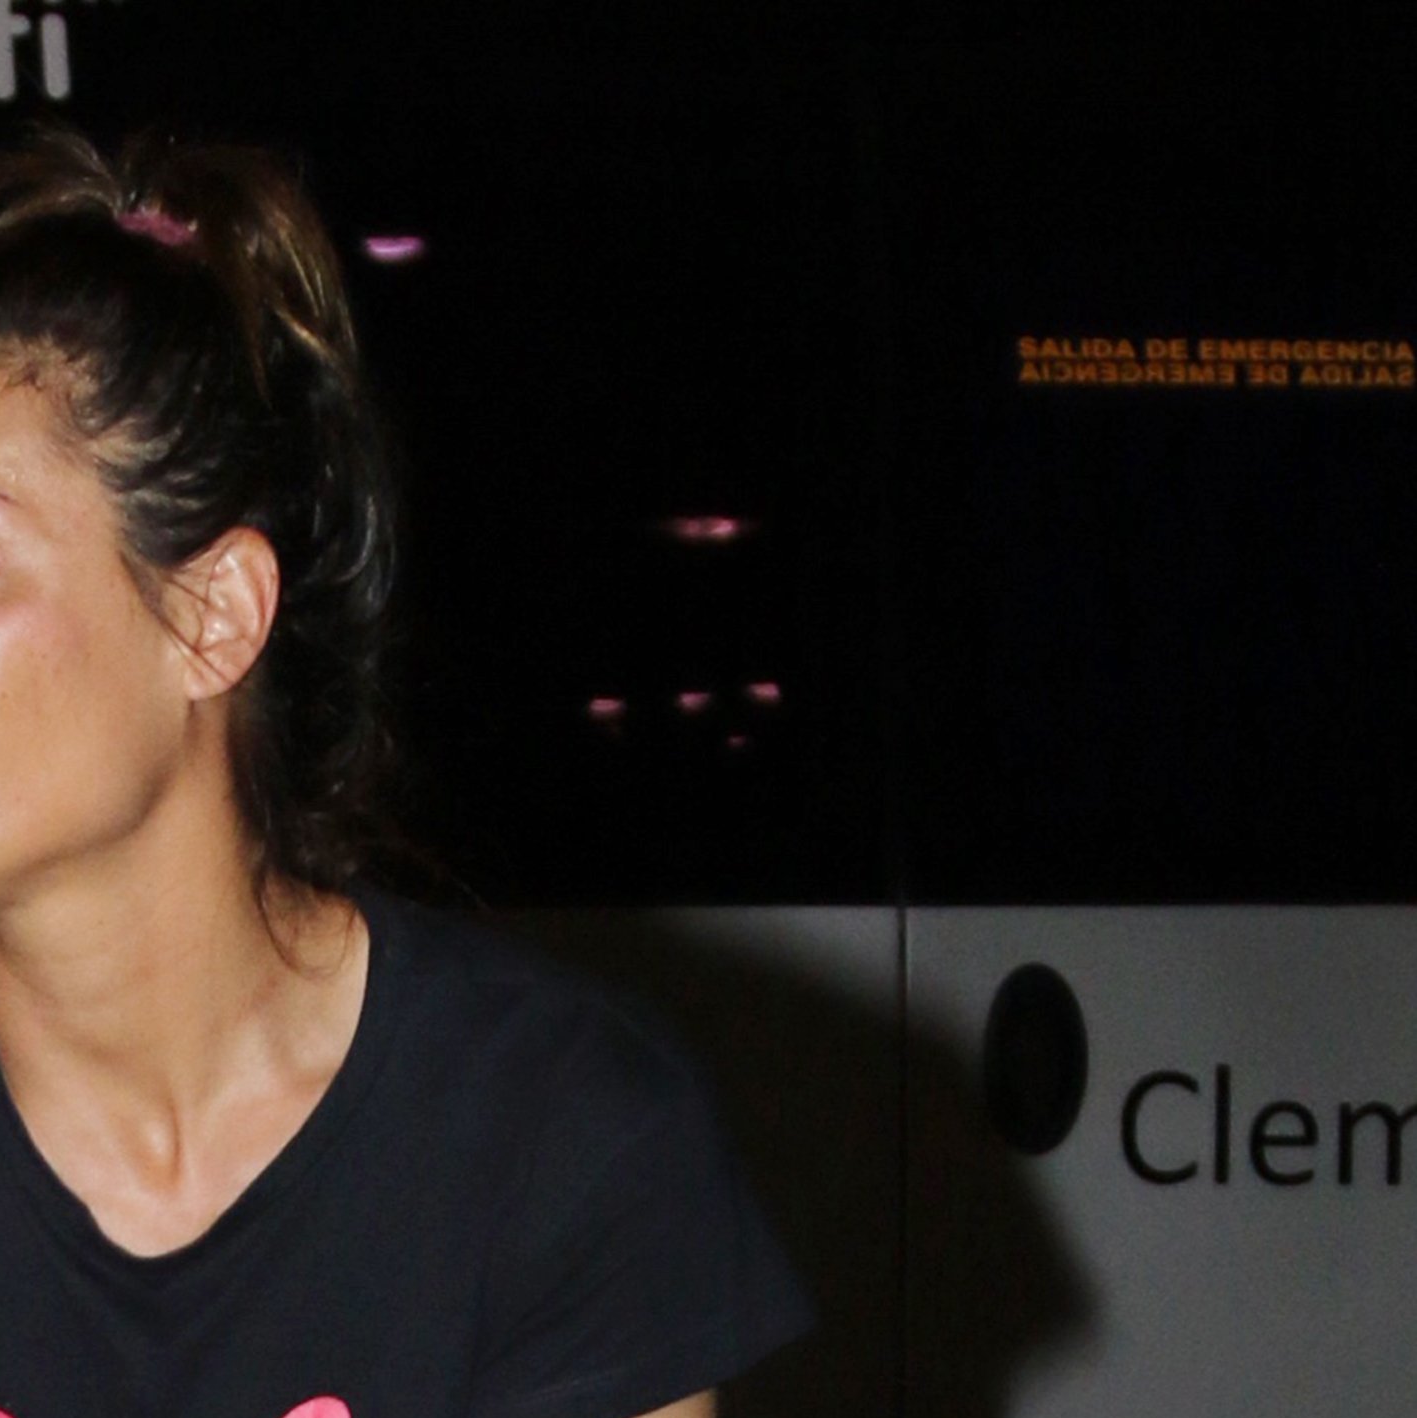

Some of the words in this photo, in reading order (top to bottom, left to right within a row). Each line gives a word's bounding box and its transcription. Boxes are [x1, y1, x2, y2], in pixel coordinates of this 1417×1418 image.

[1018, 336, 1135, 358] SALIDA
[1146, 338, 1189, 360] DE
[1199, 339, 1415, 361] EMERGENCIA
[1121, 1064, 1417, 1184] Clem
